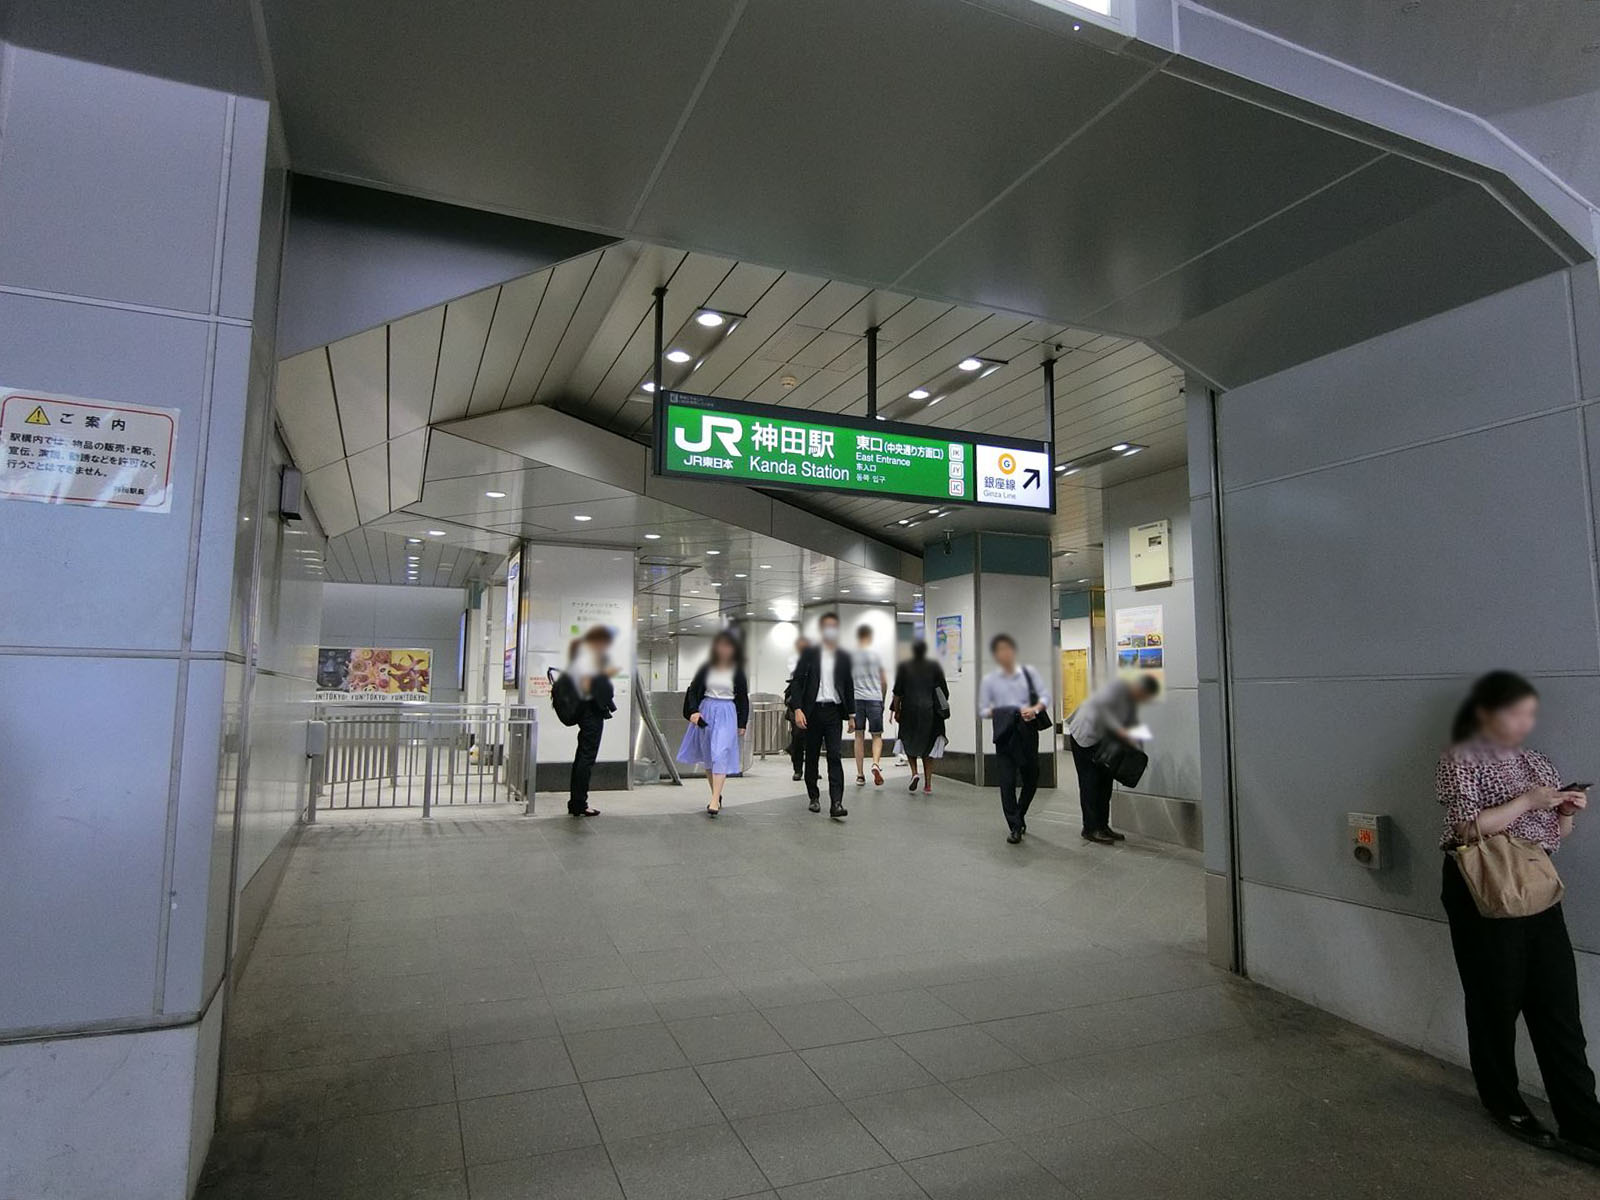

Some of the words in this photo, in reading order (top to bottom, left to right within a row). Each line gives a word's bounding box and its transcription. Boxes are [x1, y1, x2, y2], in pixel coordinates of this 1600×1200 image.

[674, 414, 743, 457] JR
[750, 421, 835, 459] 神田駅
[683, 454, 734, 470] JR東日本
[855, 451, 874, 463] East
[876, 455, 911, 467] Entrance
[749, 456, 797, 476] Kanda
[801, 461, 850, 481] Station
[984, 476, 1016, 491] 銀座線
[983, 489, 1002, 498] Ginza
